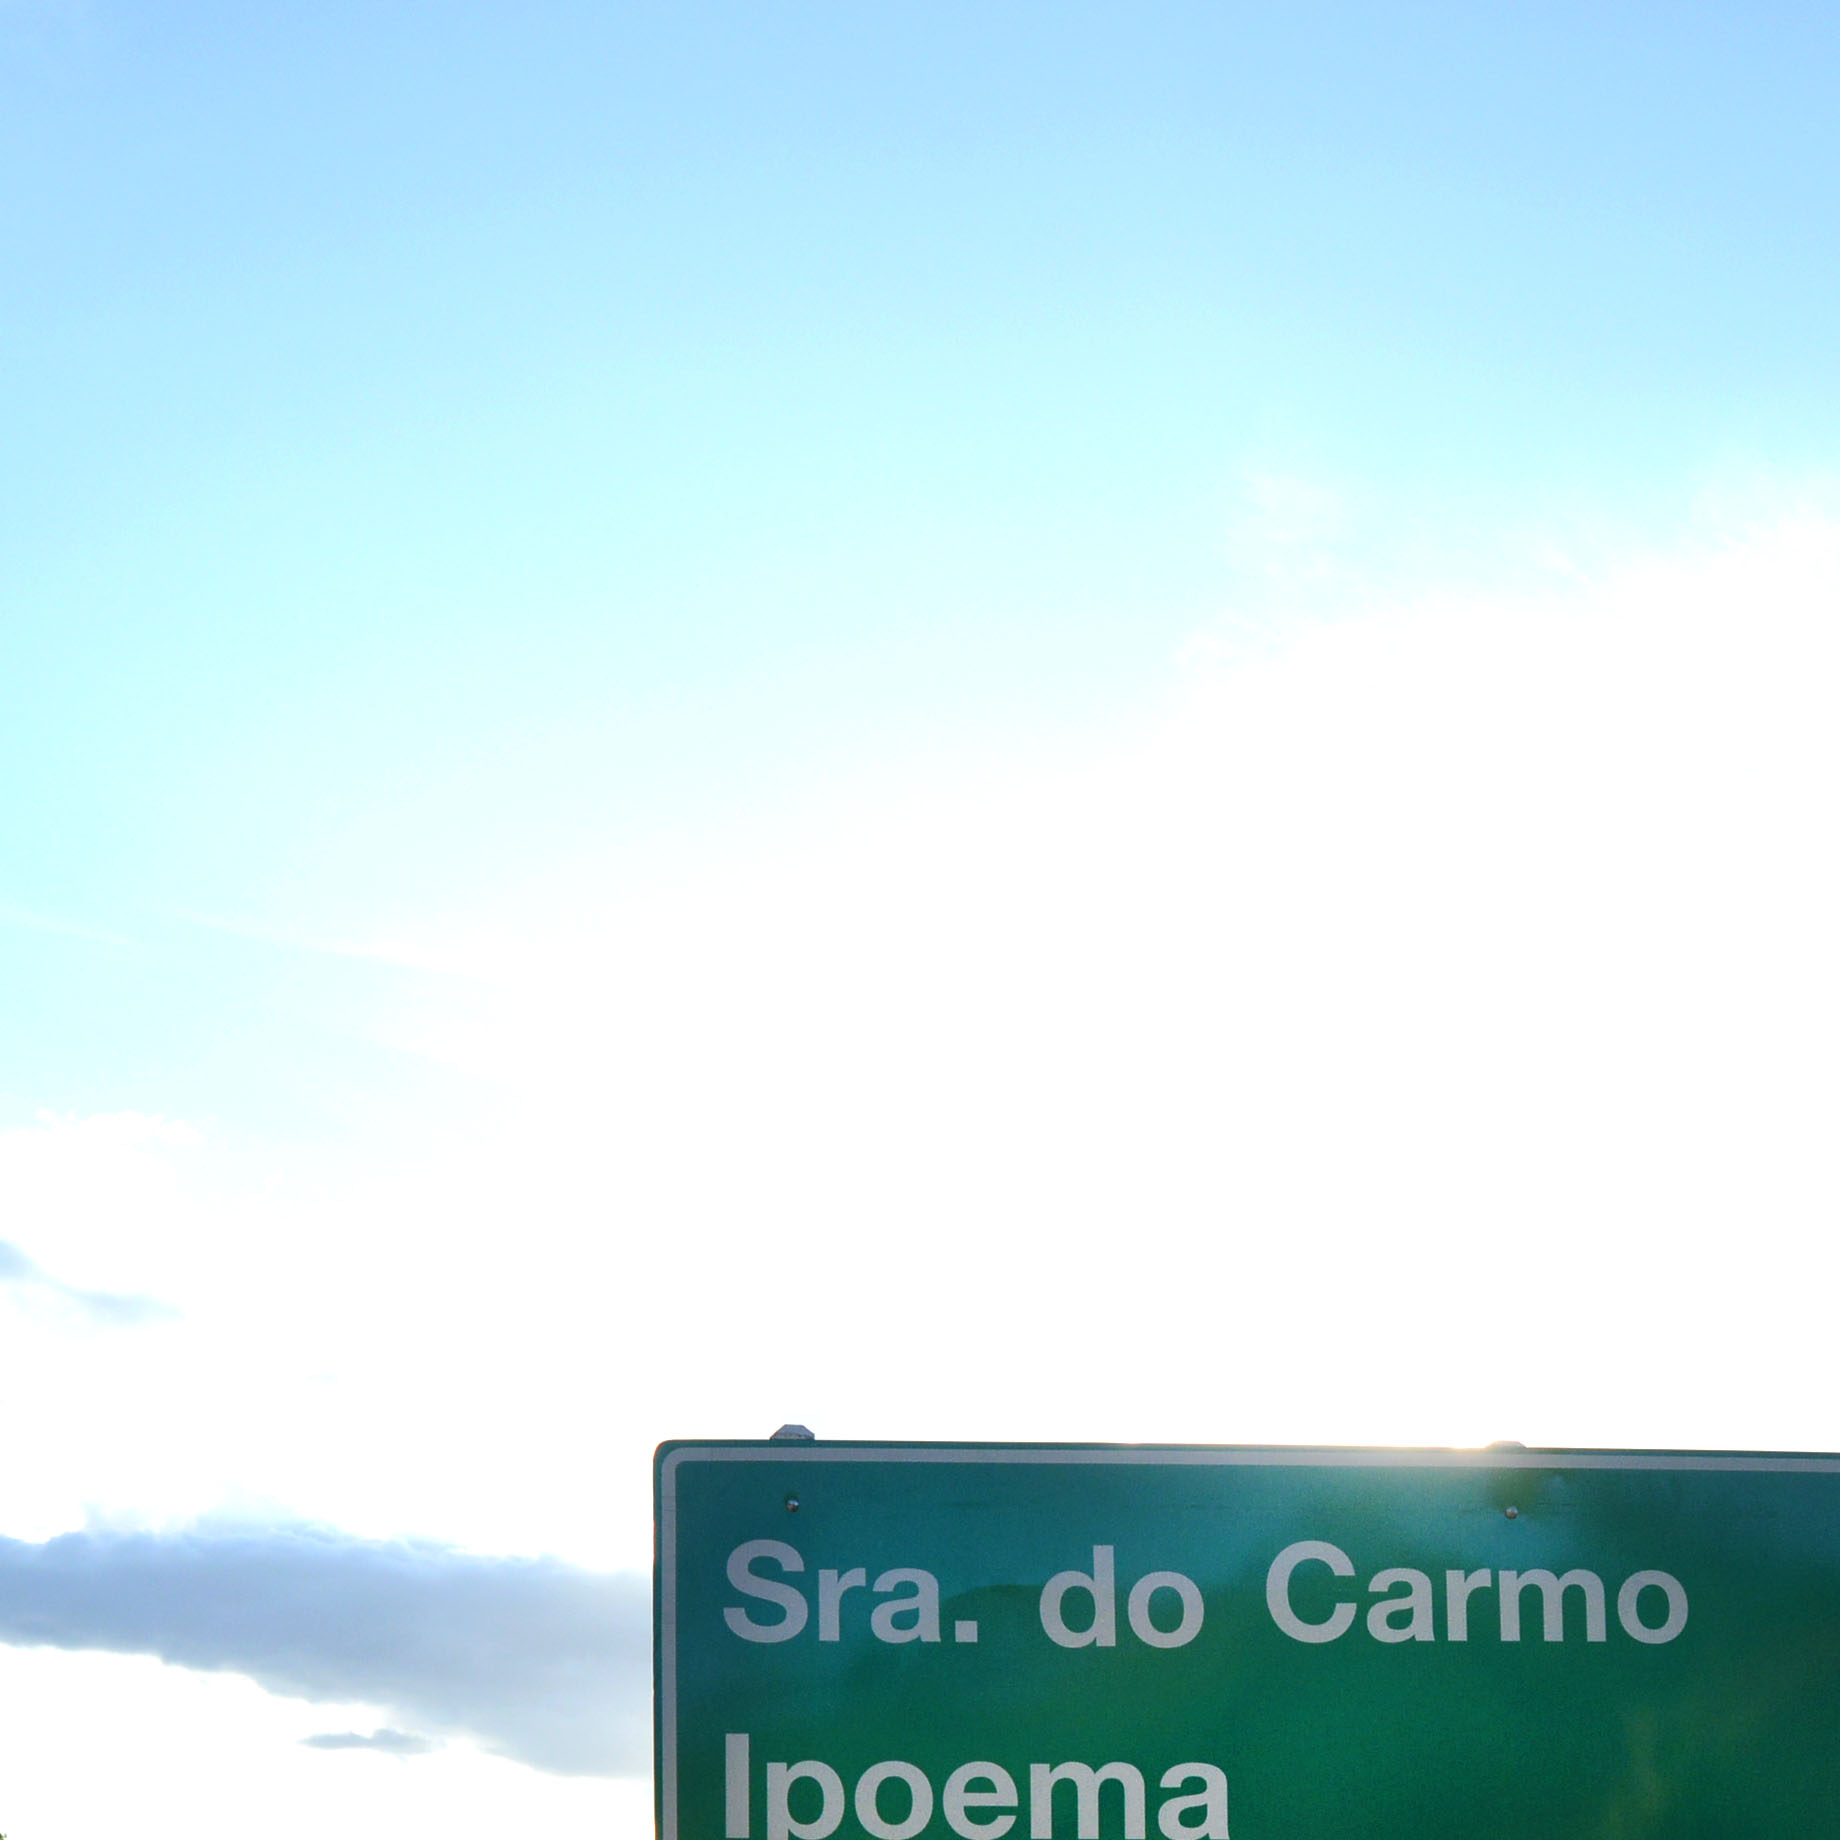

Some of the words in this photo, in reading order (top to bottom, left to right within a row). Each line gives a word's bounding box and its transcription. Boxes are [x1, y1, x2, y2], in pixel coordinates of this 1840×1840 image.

[721, 1538, 979, 1644] Sra.
[1040, 1546, 1204, 1648] do
[1267, 1541, 1687, 1643] Carmo
